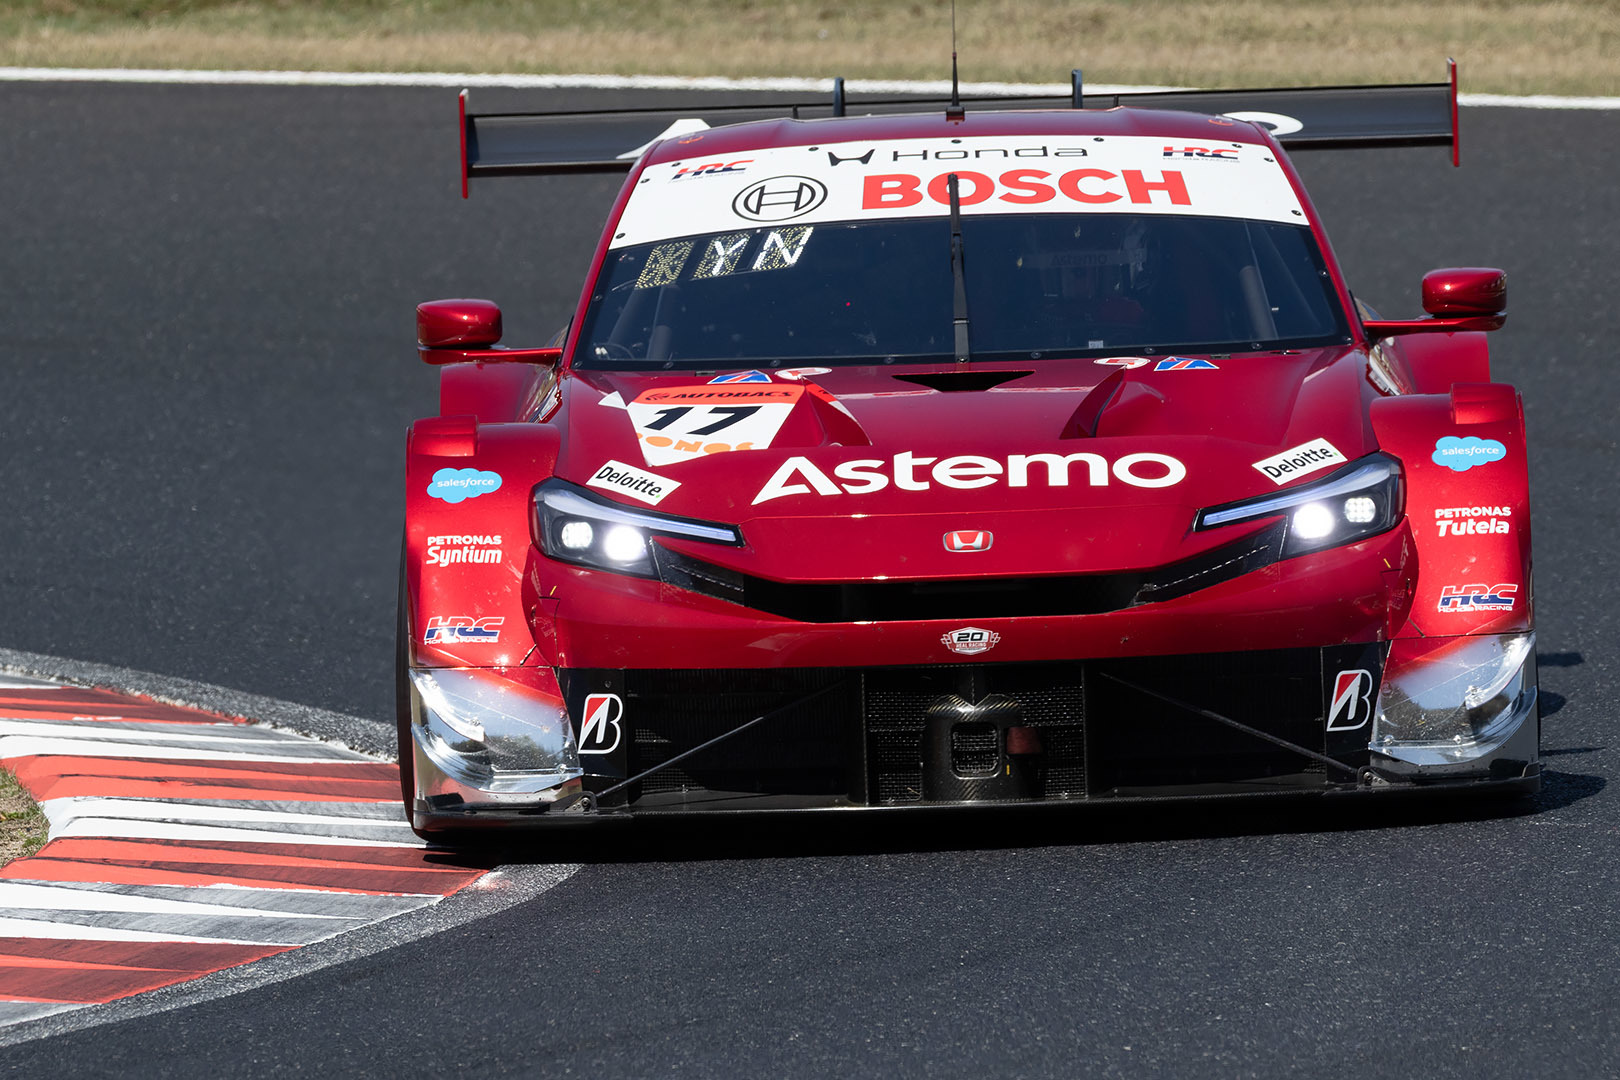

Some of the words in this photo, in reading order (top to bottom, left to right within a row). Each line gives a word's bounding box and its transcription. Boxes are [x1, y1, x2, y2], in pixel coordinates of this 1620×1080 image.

[892, 145, 1089, 162] Honda
[1162, 146, 1239, 160] HRC
[671, 159, 755, 180] HRC
[862, 168, 1192, 210] BOSCH
[671, 390, 794, 399] AUTOBACS
[643, 405, 763, 436] 17
[1442, 446, 1500, 457] salesforce
[436, 477, 495, 488] salesforce
[750, 451, 1188, 506] Astemo
[1435, 506, 1512, 518] PETRONAS
[1436, 518, 1510, 537] Tutela
[427, 535, 502, 546] PETRONAS
[426, 546, 502, 567] Syntium
[1437, 583, 1518, 608] HRC
[424, 616, 505, 640] HRC
[956, 632, 984, 642] 20
